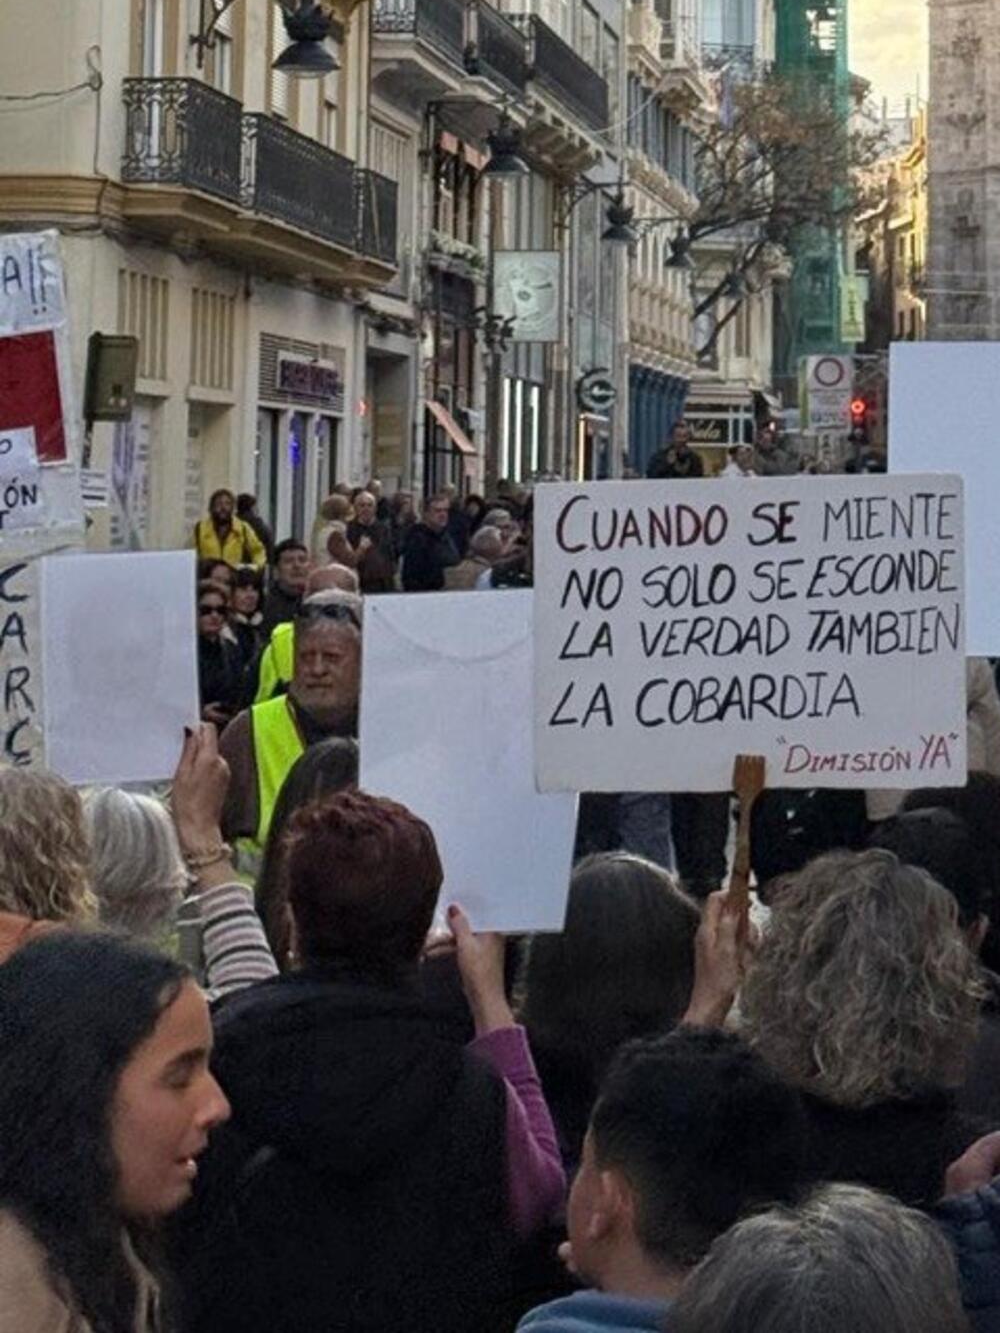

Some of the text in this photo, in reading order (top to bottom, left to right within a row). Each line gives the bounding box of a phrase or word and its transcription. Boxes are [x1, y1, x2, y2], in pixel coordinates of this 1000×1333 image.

[556, 493, 957, 552] CUANDO SE MIENTE
[561, 549, 957, 610] NO SOLO SE ESCONDE
[559, 604, 960, 660] LA VERDAD TAMBIEN
[549, 672, 861, 727] LA COBARDIA
